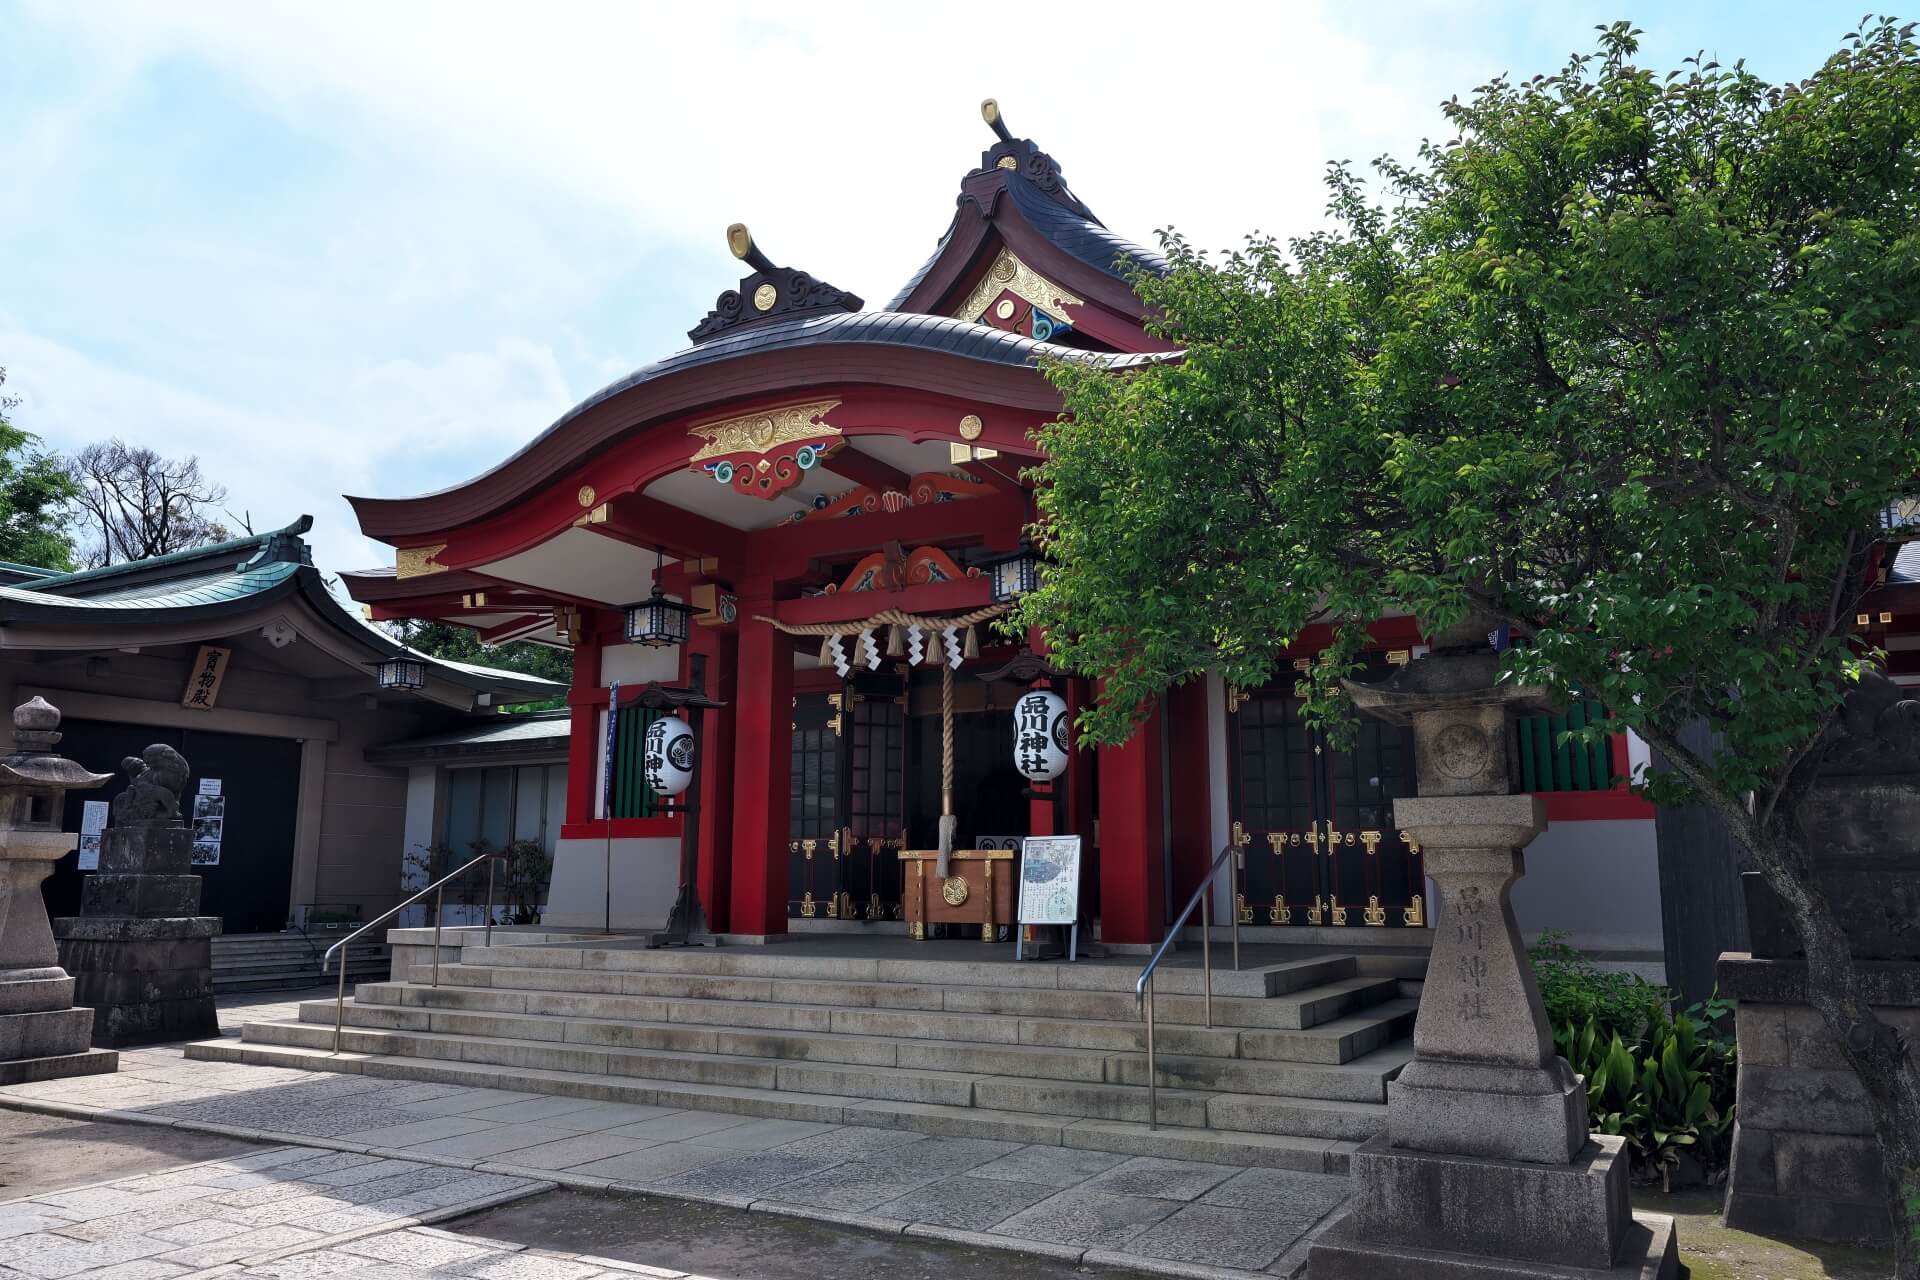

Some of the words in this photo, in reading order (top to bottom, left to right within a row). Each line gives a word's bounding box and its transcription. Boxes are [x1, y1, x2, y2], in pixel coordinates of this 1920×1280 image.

[645, 721, 668, 790] 品川神社
[1019, 695, 1050, 774] 品川神社
[1457, 885, 1489, 1023] 品川神社
